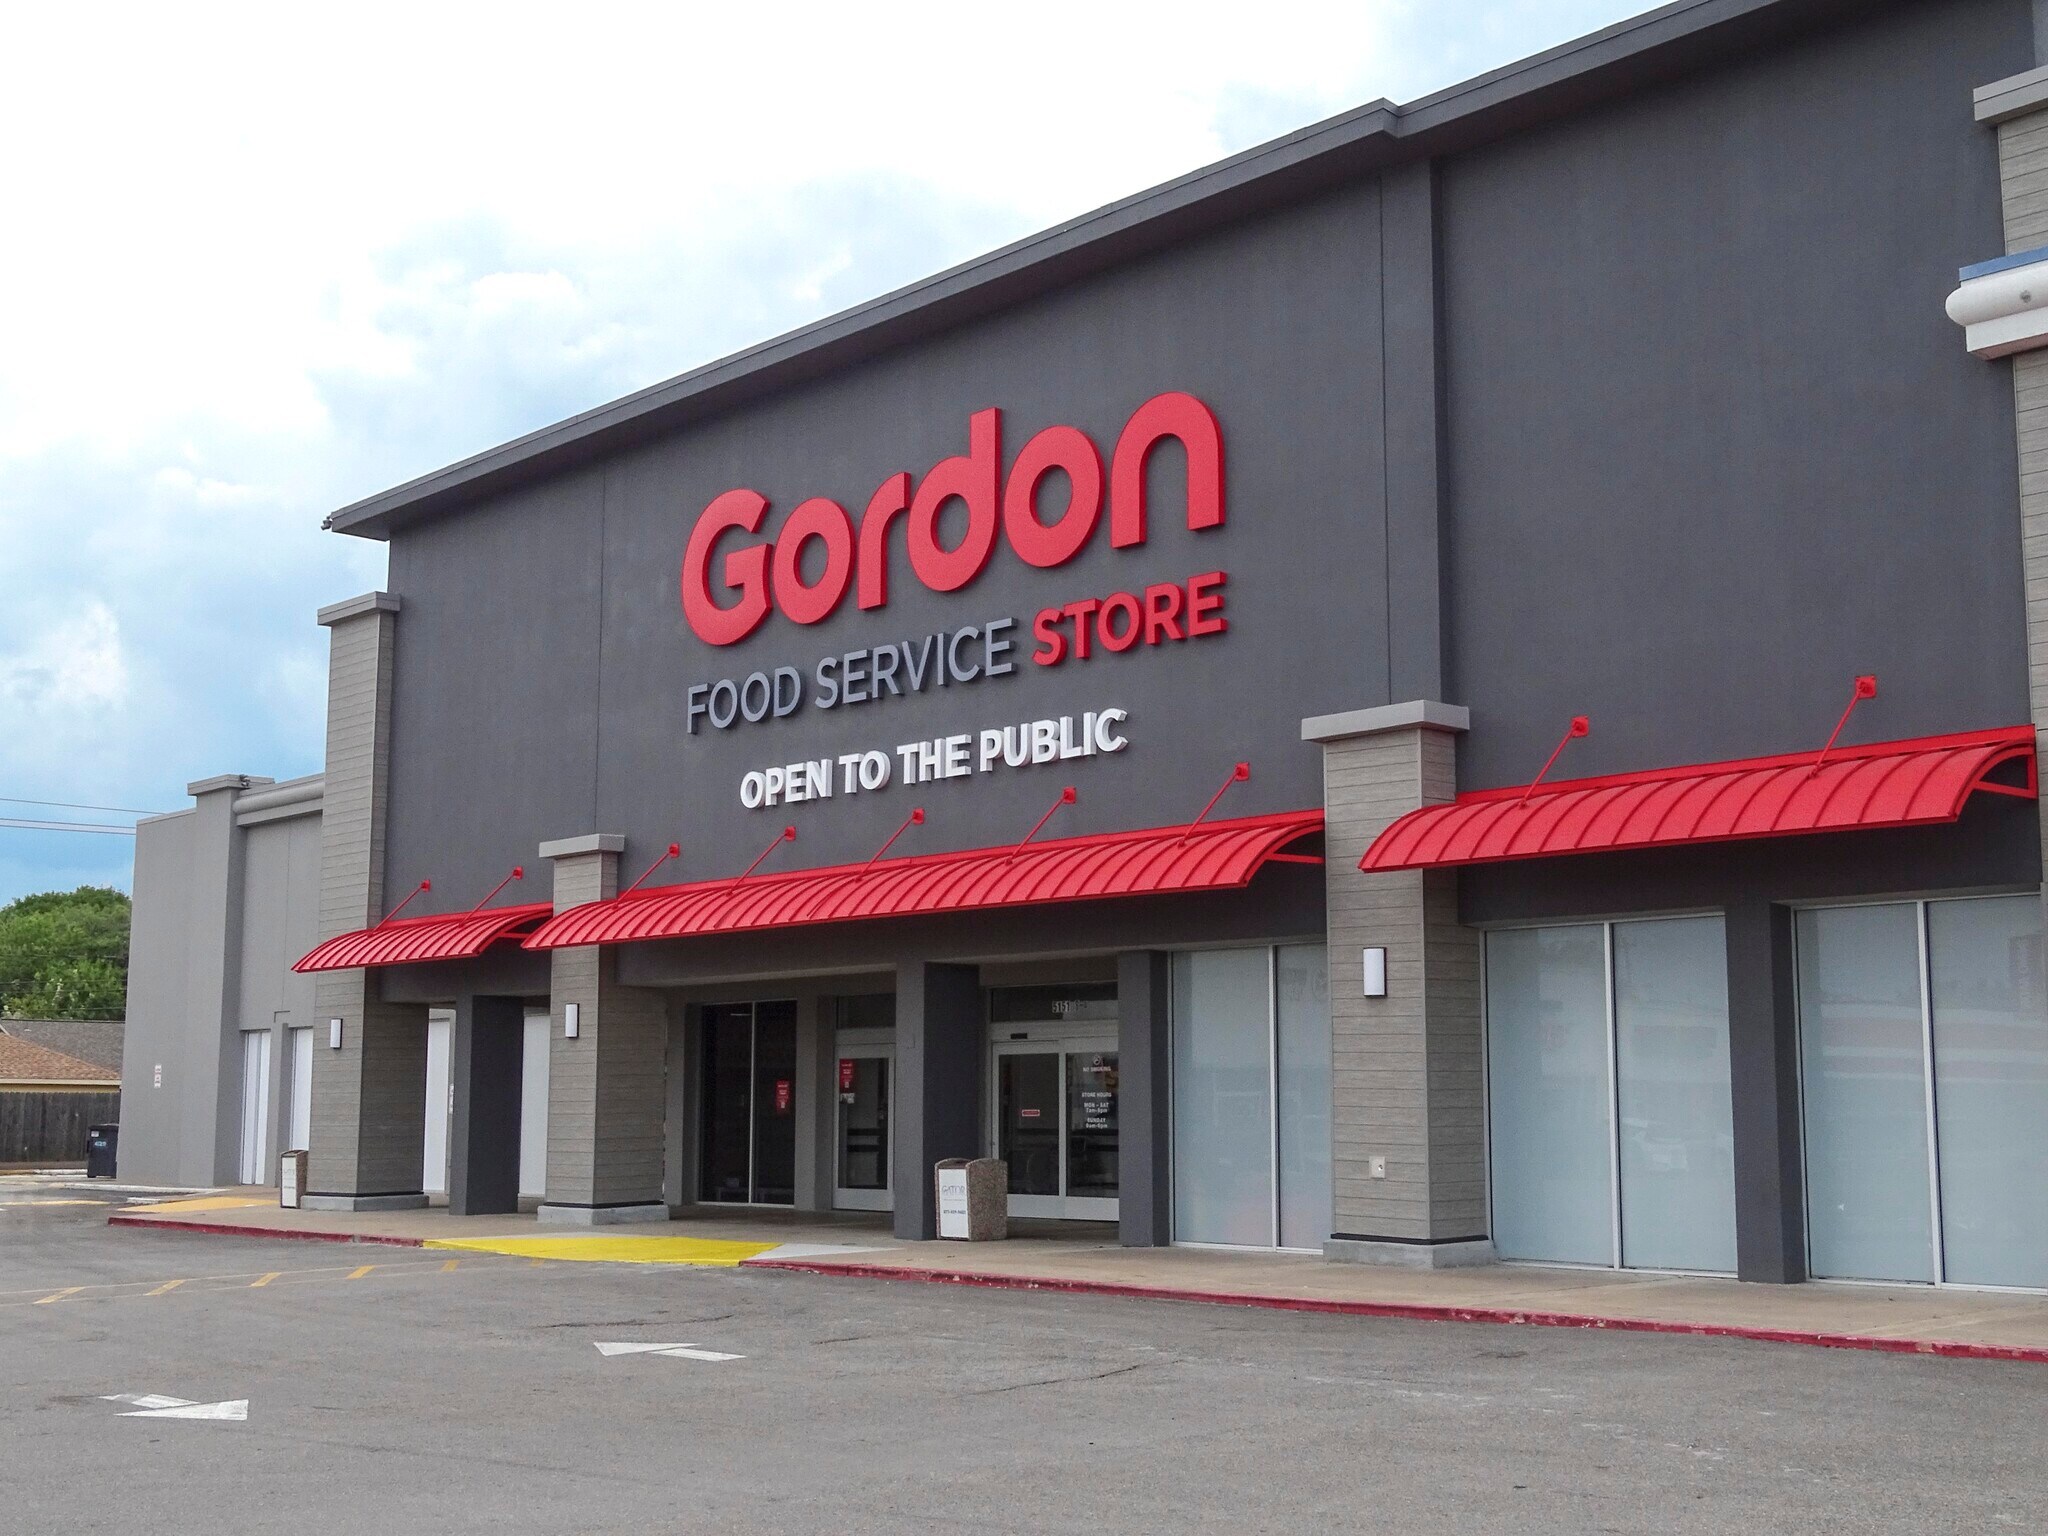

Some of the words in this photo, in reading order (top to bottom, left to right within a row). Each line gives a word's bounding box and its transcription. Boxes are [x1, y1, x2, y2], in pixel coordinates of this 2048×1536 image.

[681, 392, 1226, 646] Gordon
[687, 665, 804, 734] FOOD
[814, 616, 1017, 709] SERVICE
[1031, 570, 1228, 666] STORE
[740, 758, 833, 809] OPEN
[838, 750, 891, 794] TO
[896, 733, 972, 785] THE
[979, 707, 1128, 772] PUBLIC
